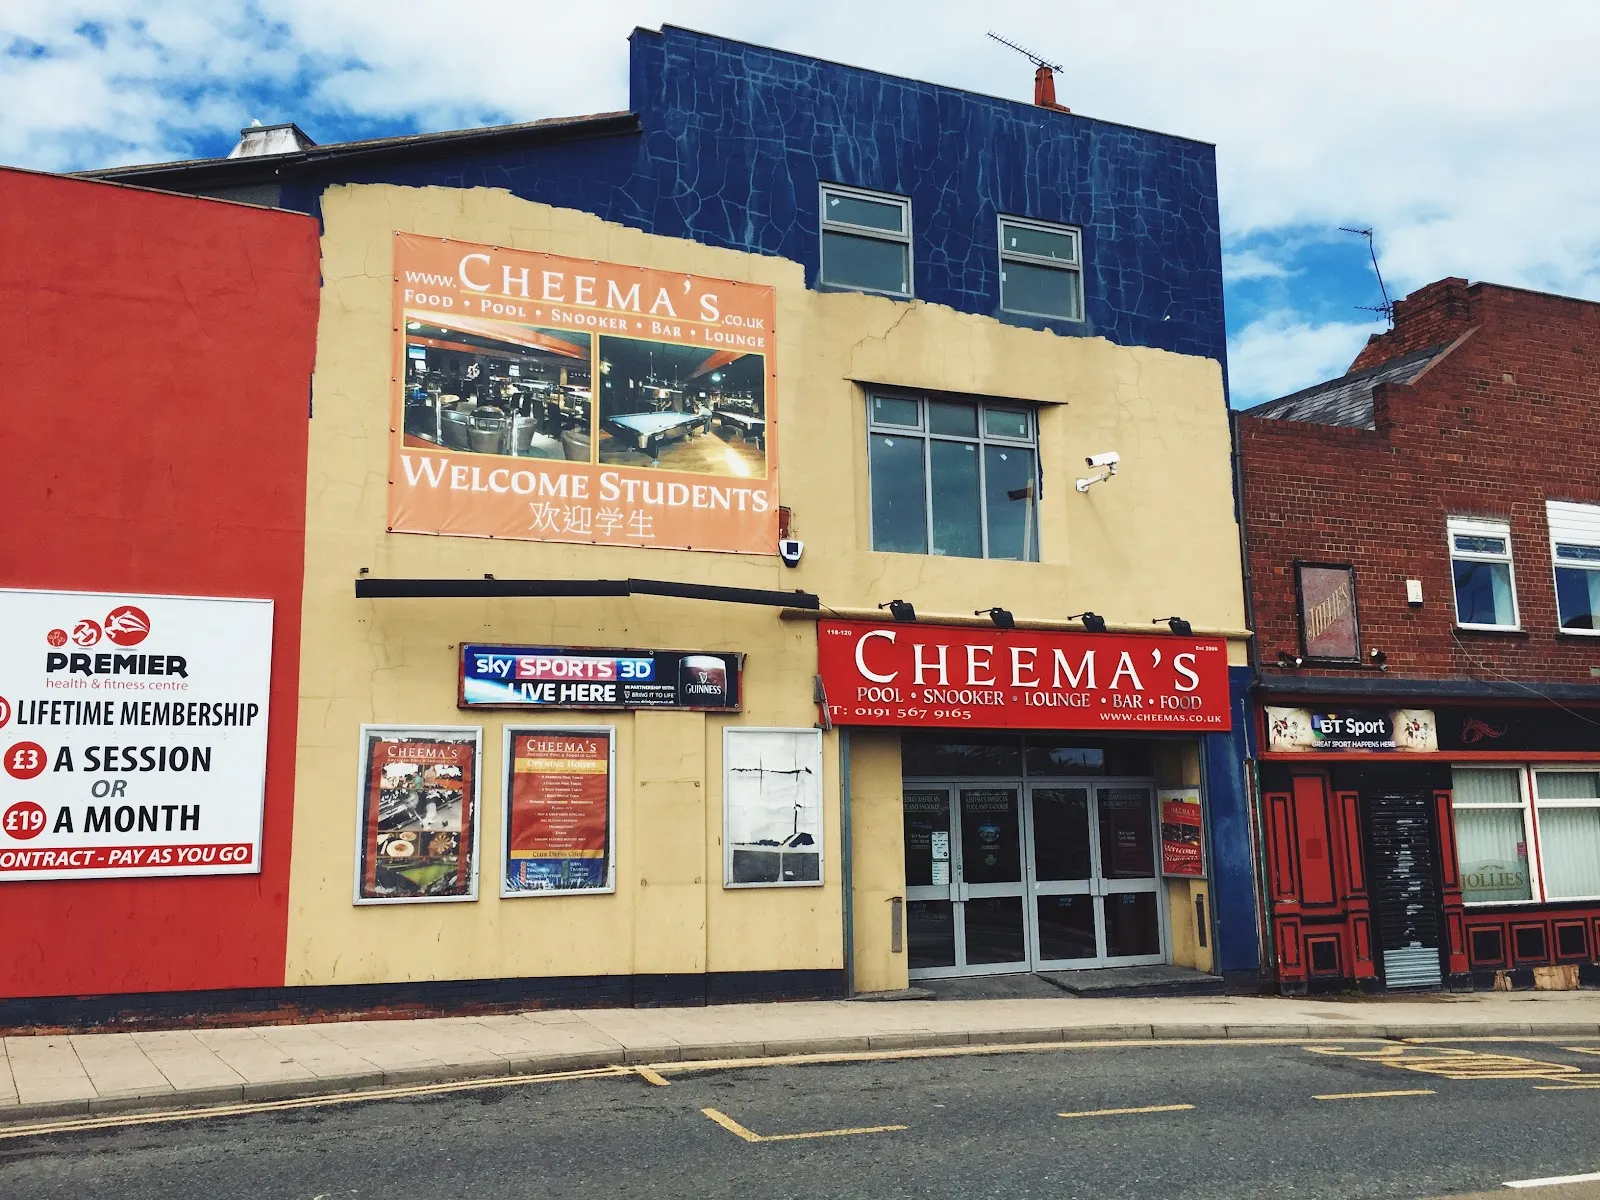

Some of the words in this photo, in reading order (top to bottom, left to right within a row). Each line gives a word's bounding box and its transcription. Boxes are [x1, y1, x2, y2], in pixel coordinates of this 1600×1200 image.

[404, 288, 454, 308] FOOD
[481, 298, 527, 318] POOL
[551, 308, 628, 331] SNOOKER
[652, 321, 682, 338] BAR
[705, 328, 766, 349] LOUNGE
[400, 455, 590, 500] WELCOME
[600, 471, 769, 513] STUDENTS
[528, 501, 656, 538] 欢迎学生
[46, 652, 189, 679] PREMIER
[476, 655, 512, 677] sky
[520, 659, 613, 678] SPORTS
[620, 661, 651, 678] 3D
[855, 629, 1200, 692] CHEEMA'S
[46, 678, 87, 689] health
[91, 679, 101, 689] &
[104, 678, 145, 690] fitness
[148, 680, 189, 691] centre
[508, 682, 556, 701] LIVE
[561, 683, 617, 702] HERE
[684, 683, 722, 695] GUINNESS
[857, 687, 904, 703] POOL
[923, 688, 1005, 706] SNOOKER
[1025, 691, 1091, 708] LOUNGE
[1113, 693, 1143, 709] BAR
[1160, 695, 1202, 710] FOOD
[17, 700, 114, 726] LIFETIME
[120, 701, 259, 727] MEMBERSHIP
[830, 705, 847, 715] T:
[855, 707, 890, 718] 0191
[897, 706, 928, 719] 567
[934, 707, 971, 720] 9165
[1320, 719, 1343, 733] BT
[1346, 718, 1385, 736] Sport
[387, 745, 458, 758] CHEEMA'S
[527, 739, 597, 752] CHEEMA'S
[12, 749, 39, 770] £3
[53, 746, 74, 772] A
[83, 746, 212, 772] SESSION
[527, 759, 565, 768] OPENING
[91, 780, 128, 798] OR
[6, 811, 43, 831] £19
[53, 806, 74, 834] A
[84, 805, 201, 833] MONTH
[0, 850, 95, 868] ONTRACT
[108, 849, 146, 865] PAY
[147, 848, 172, 863] AS
[178, 847, 216, 863] YOU
[219, 846, 248, 862] GO
[1461, 872, 1524, 892] JOLLIES
